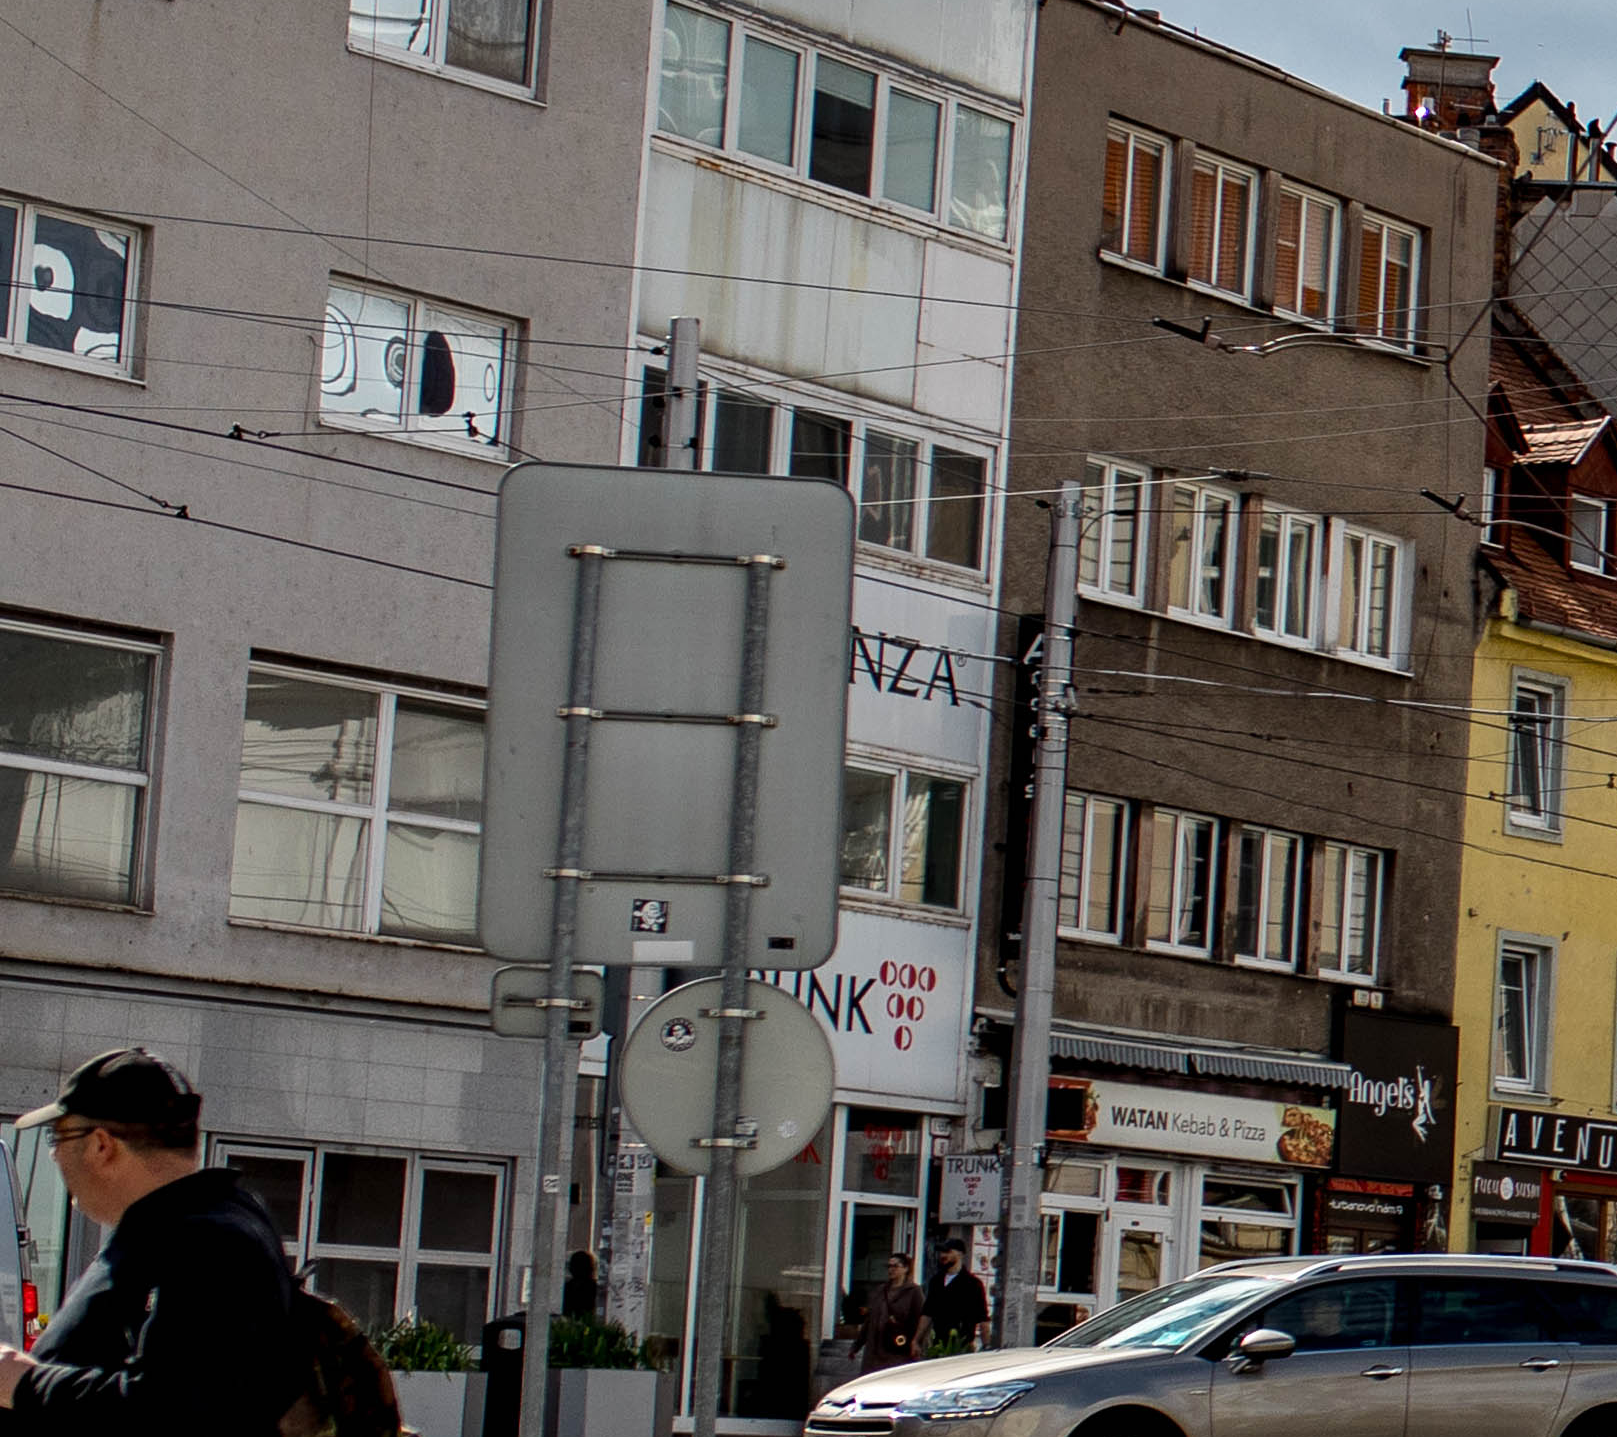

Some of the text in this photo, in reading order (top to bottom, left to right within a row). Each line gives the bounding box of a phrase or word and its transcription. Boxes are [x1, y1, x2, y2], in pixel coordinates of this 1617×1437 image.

[849, 625, 961, 707] NZA
[1349, 1071, 1414, 1116] Angel's
[1112, 1105, 1265, 1141] WATAN Kebab & Pizza
[946, 1157, 999, 1174] TRUNK
